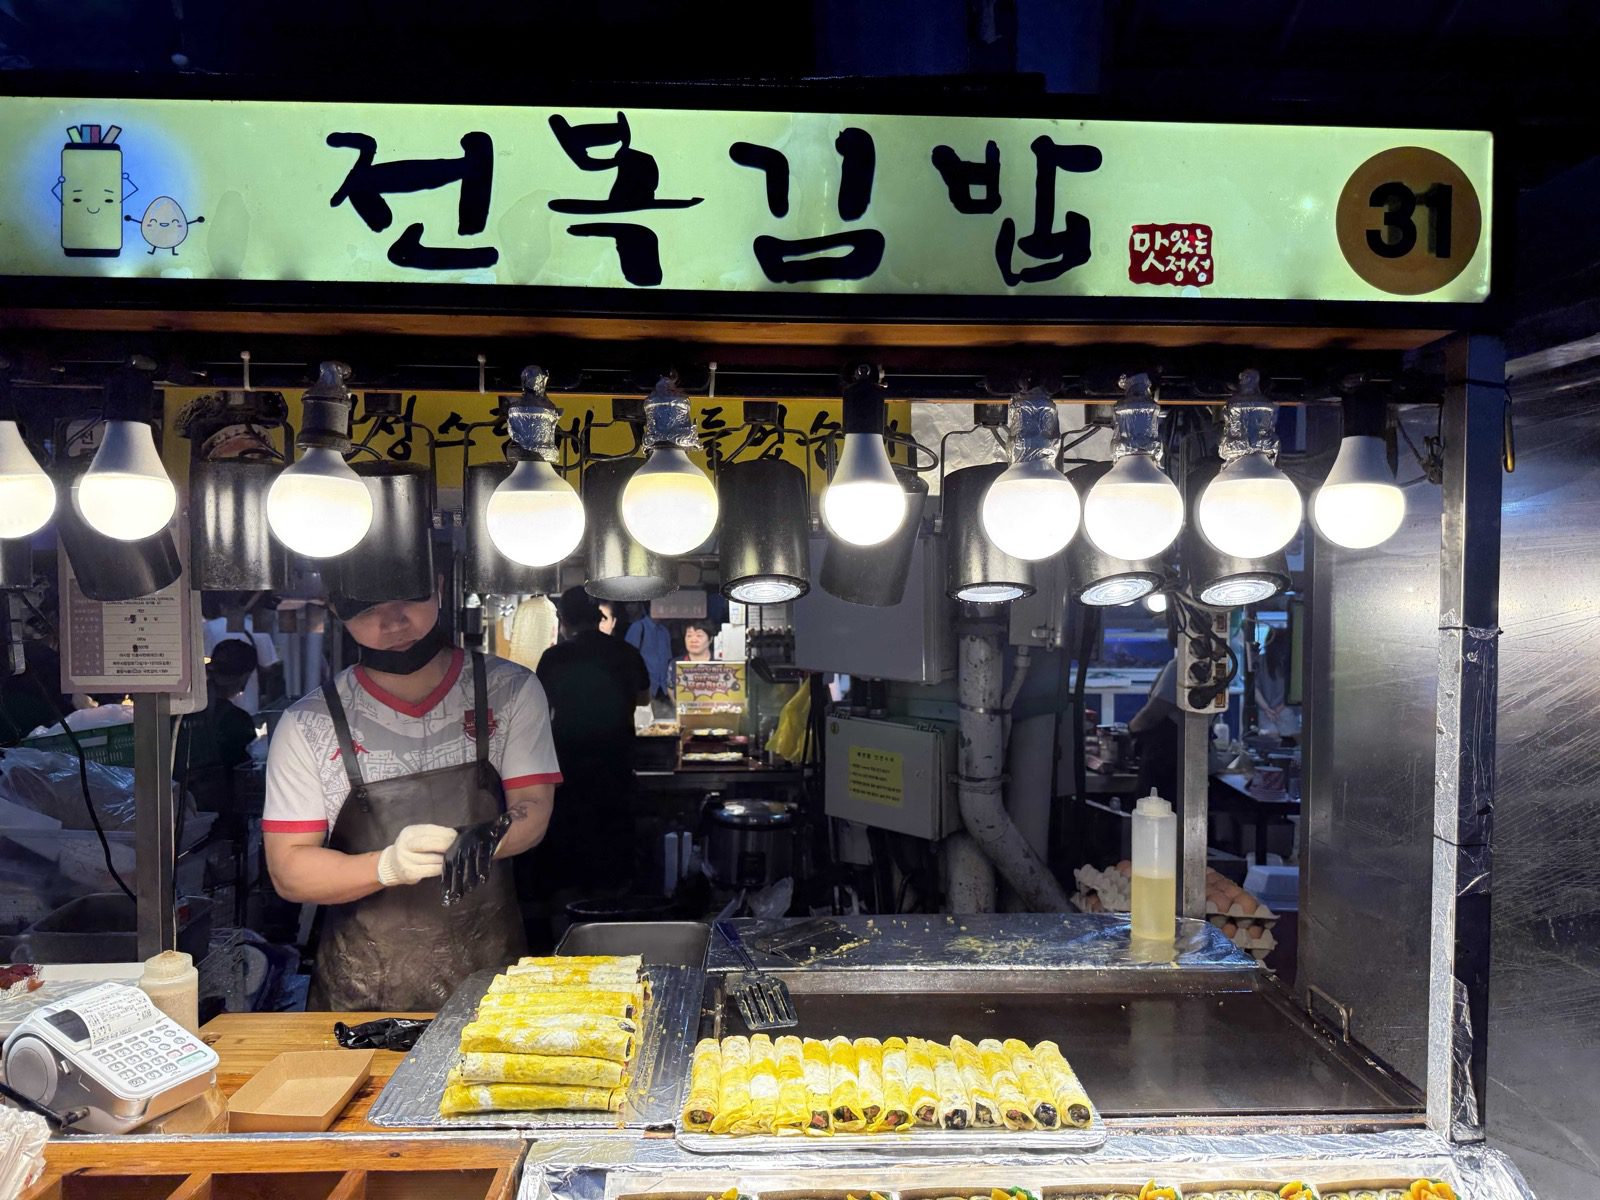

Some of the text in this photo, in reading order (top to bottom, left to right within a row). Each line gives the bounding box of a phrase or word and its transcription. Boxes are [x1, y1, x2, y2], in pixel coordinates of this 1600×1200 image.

[327, 111, 1103, 287] 전복김밥
[1366, 181, 1453, 260] 31
[1132, 228, 1208, 273] 맛있는
[1165, 255, 1211, 283] 정성
